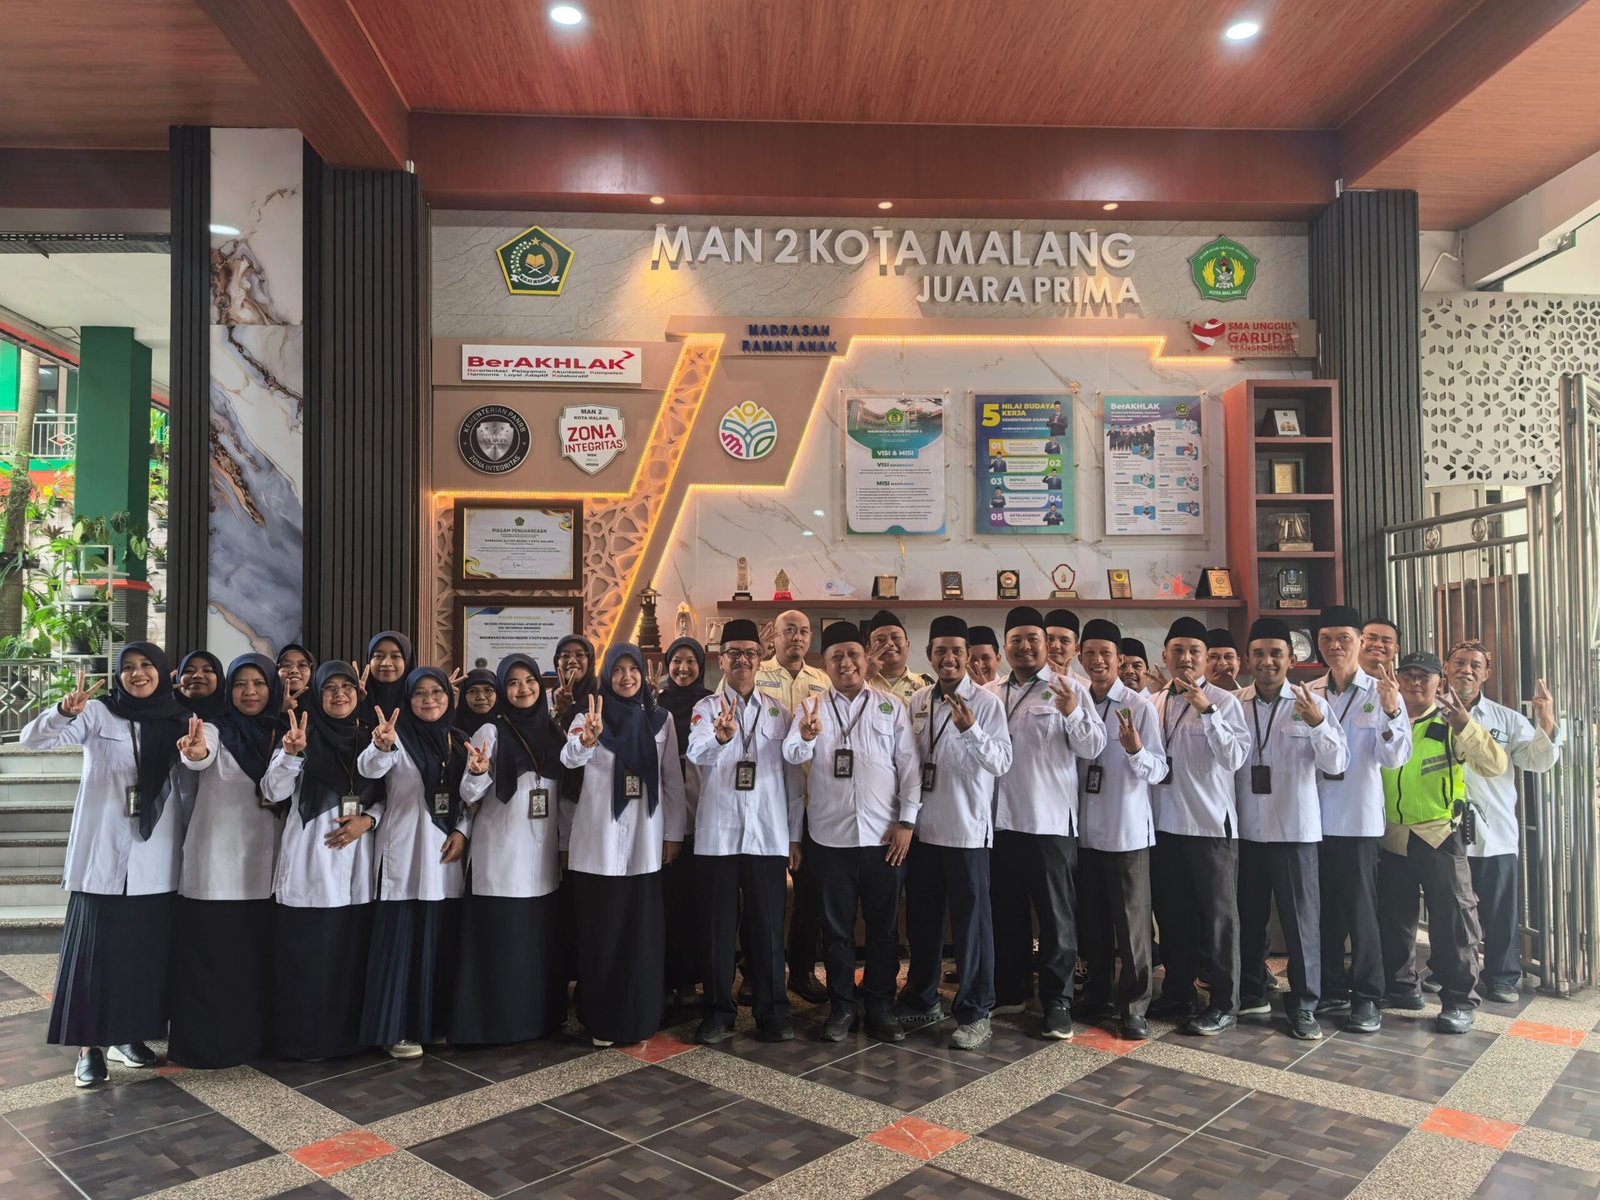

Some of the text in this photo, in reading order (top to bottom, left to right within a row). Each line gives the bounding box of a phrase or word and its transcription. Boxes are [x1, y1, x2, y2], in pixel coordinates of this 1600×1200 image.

[651, 225, 1136, 268] MAN 2 KOTA MALANG
[916, 276, 1141, 304] JUARA PRIMA
[748, 324, 830, 336] MADRASAH
[1228, 322, 1293, 330] SMA UNGGUL
[742, 340, 838, 352] RAMAH ANAK
[1228, 332, 1295, 344] GARUDA
[467, 356, 627, 370] BerAKHLAK
[463, 406, 526, 433] KEMENTERIAN PANRB
[982, 404, 1002, 427] 5
[567, 424, 616, 442] ZONA
[565, 439, 624, 454] INTEGRITAS
[469, 455, 521, 472] ZONA INTEGRITAS
